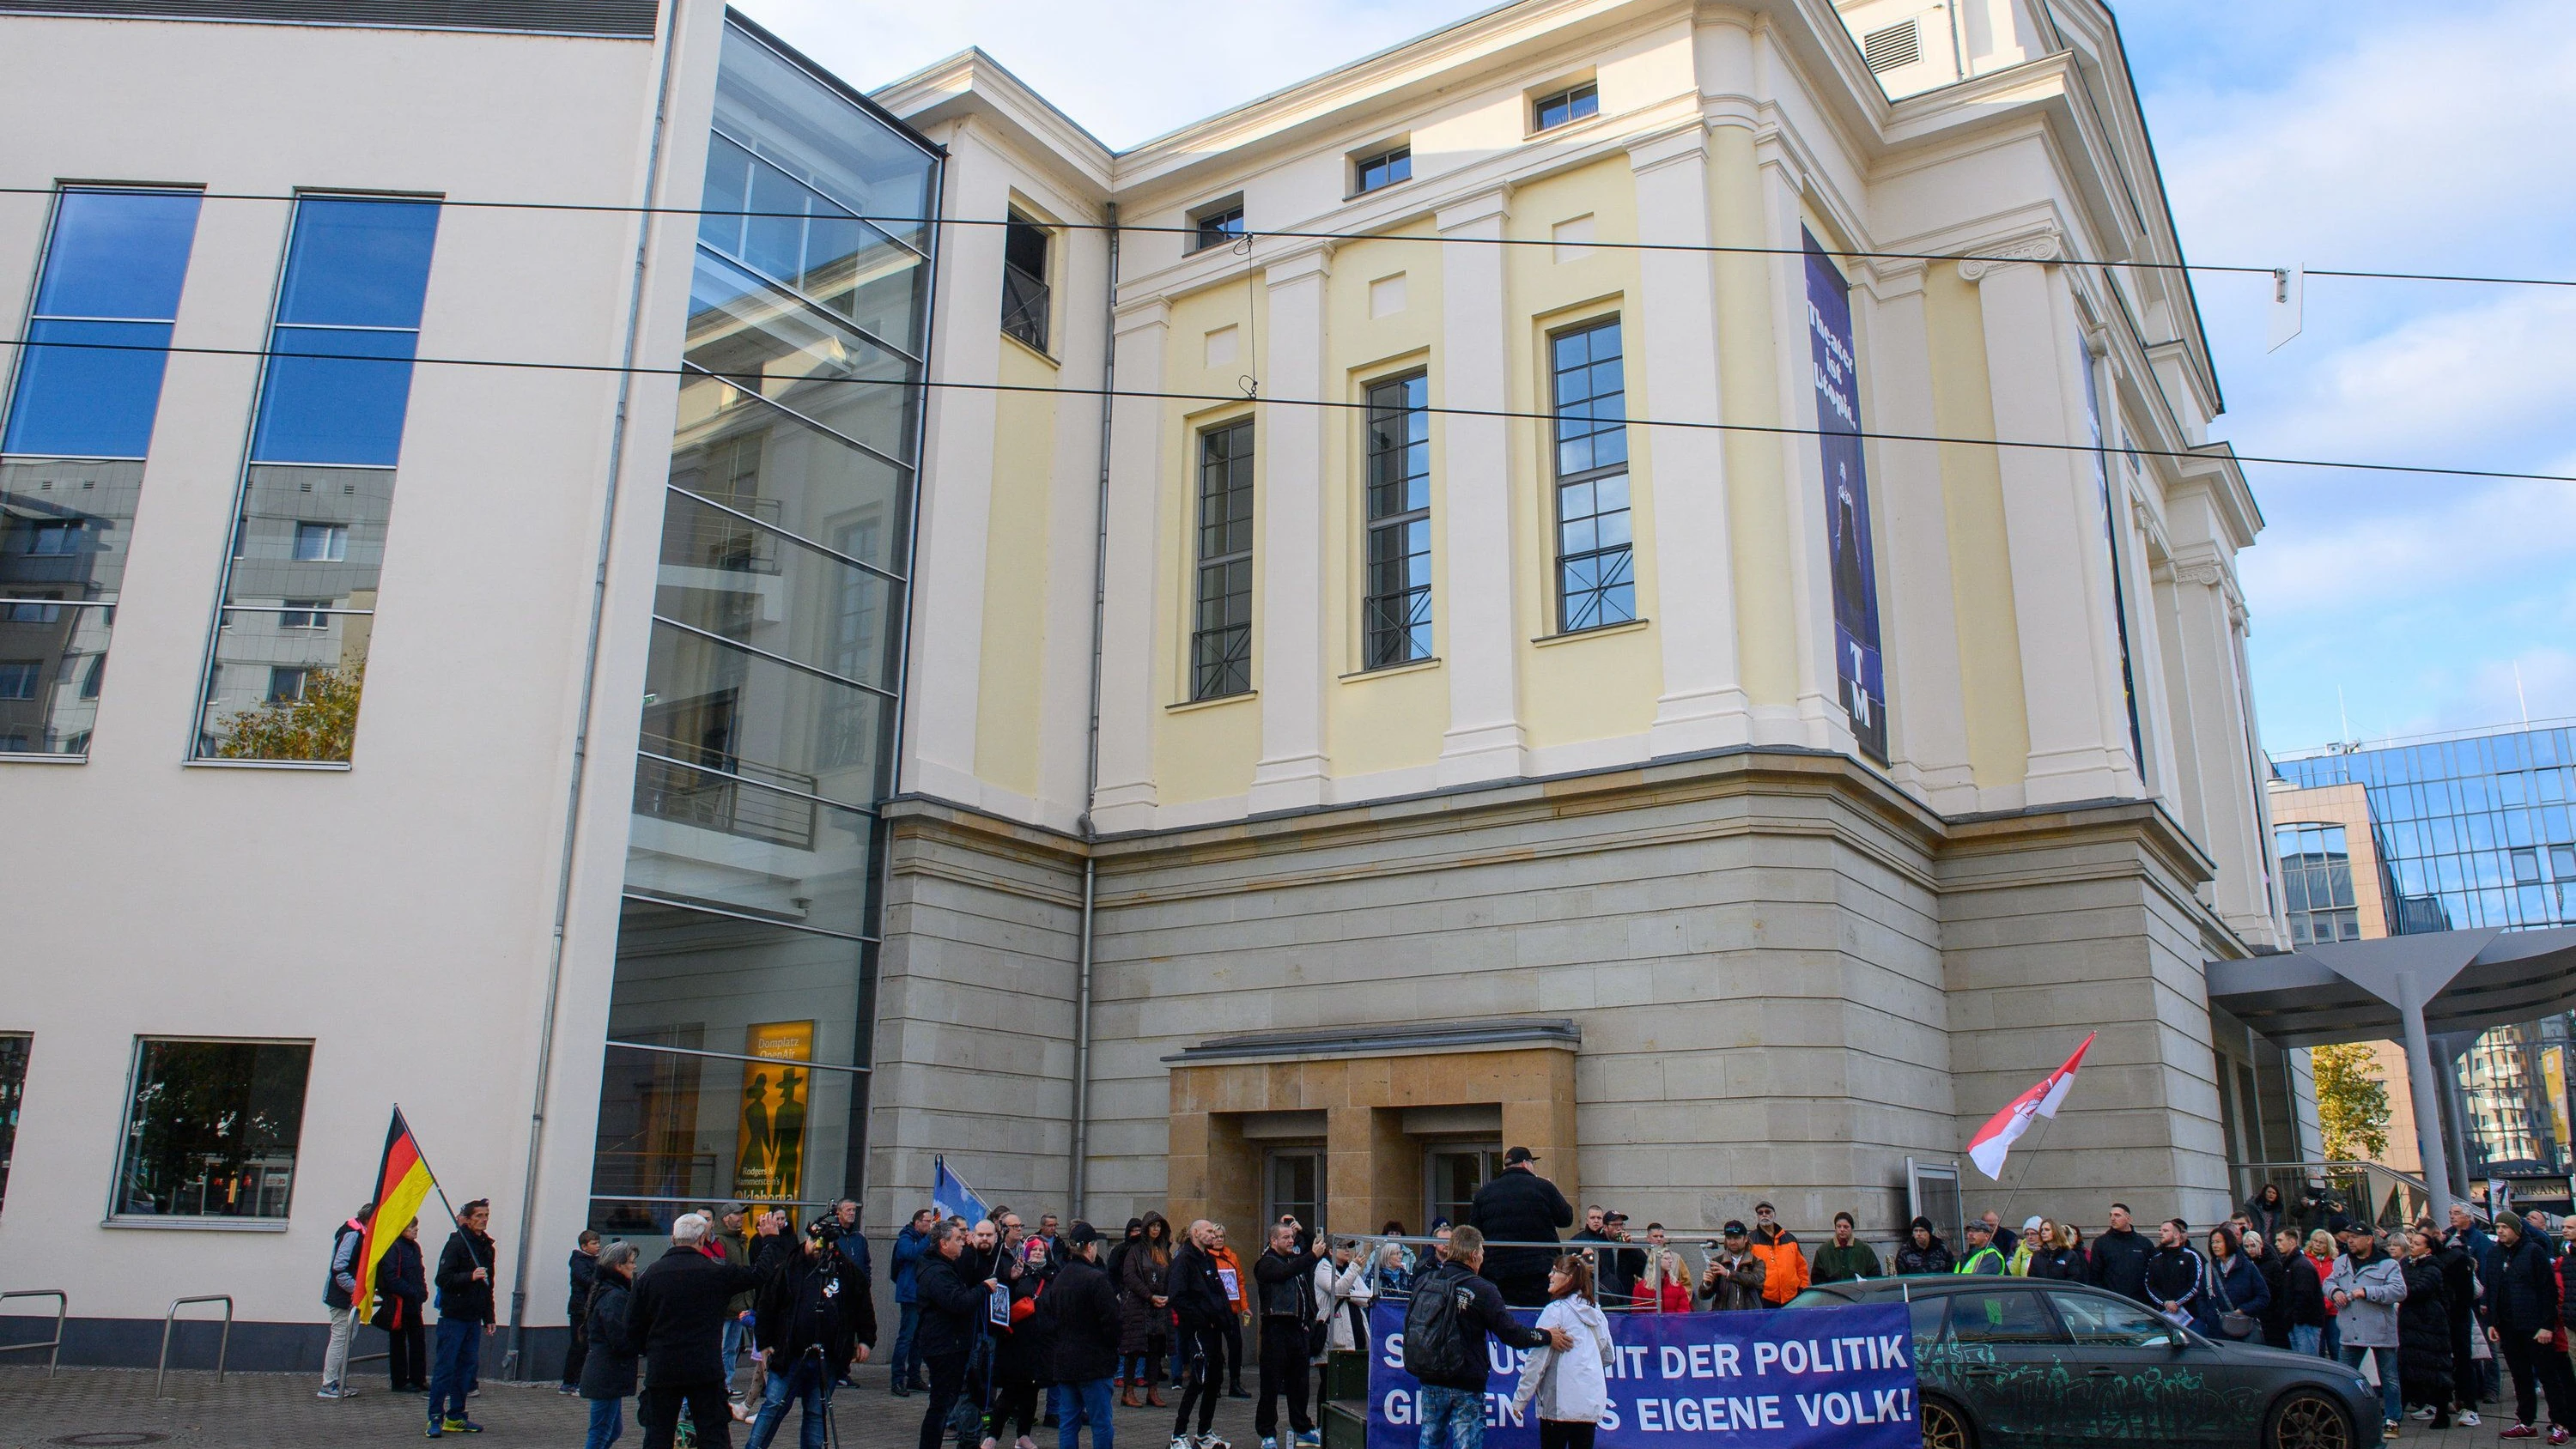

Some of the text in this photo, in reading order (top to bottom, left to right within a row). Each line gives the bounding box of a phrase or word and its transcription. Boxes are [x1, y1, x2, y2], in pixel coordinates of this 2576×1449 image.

[1807, 300, 1854, 374] Theater
[1826, 347, 1843, 385] ist
[1850, 640, 1863, 686] T
[1850, 680, 1871, 729] M
[758, 1037, 799, 1051] Domplatz
[743, 1167, 774, 1177] Rodgers &
[2511, 1185, 2569, 1197] AURANT
[1660, 1343, 1742, 1379] DER
[1753, 1335, 1908, 1375] POLITIK
[1636, 1396, 1784, 1432] EIGENE
[1795, 1388, 1911, 1428] VOLK!
